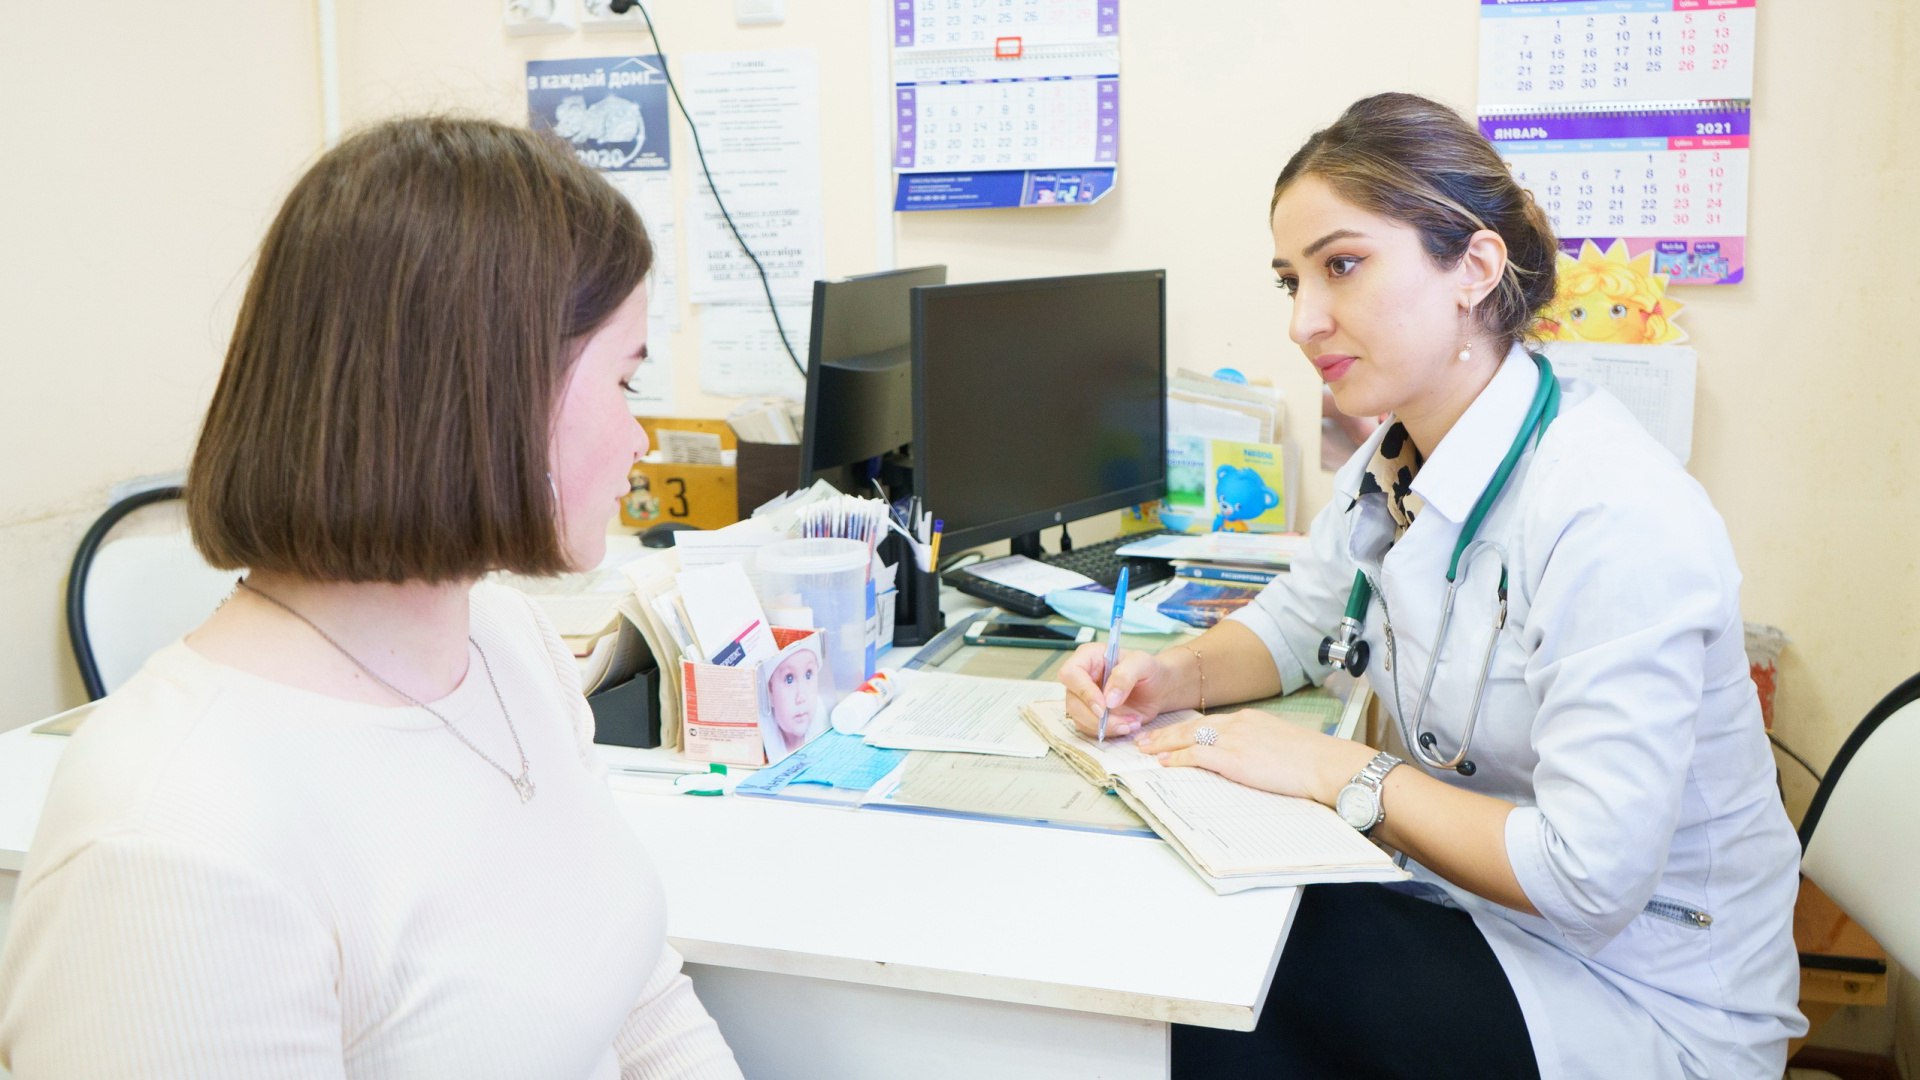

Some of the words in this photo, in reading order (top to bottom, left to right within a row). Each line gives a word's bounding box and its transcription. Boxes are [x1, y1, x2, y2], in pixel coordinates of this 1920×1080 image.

[922, 0, 935, 11] 15
[947, 0, 960, 9] 16
[921, 17, 935, 27] 22
[946, 16, 961, 26] 23
[972, 15, 986, 24] 24
[998, 13, 1012, 23] 25
[1024, 11, 1038, 22] 26
[1555, 18, 1560, 28] 1
[1587, 17, 1594, 27] 2
[1619, 16, 1626, 26] 3
[1652, 16, 1659, 24] 4
[1685, 12, 1692, 24] 5
[1718, 12, 1726, 22] 6
[921, 33, 936, 44] 29
[947, 32, 960, 42] 30
[972, 31, 984, 40] 31
[1523, 35, 1529, 44] 7
[1554, 34, 1561, 44] 8
[1586, 33, 1593, 42] 9
[1617, 31, 1630, 40] 10
[1648, 31, 1661, 40] 11
[1682, 29, 1696, 39] 12
[1715, 28, 1729, 38] 13
[1520, 51, 1532, 59] 14
[1552, 49, 1565, 59] 15
[1584, 48, 1597, 58] 16
[1616, 46, 1629, 56] 17
[1648, 46, 1662, 56] 18
[1681, 45, 1695, 55] 19
[1713, 43, 1729, 54] 20
[1518, 66, 1531, 75] 21
[1549, 65, 1564, 75] 22
[1582, 63, 1596, 73] 23
[1614, 62, 1629, 71] 24
[1646, 62, 1661, 72] 25
[1679, 60, 1694, 71] 26
[1712, 59, 1727, 70] 27
[1517, 81, 1532, 91] 28
[1549, 80, 1564, 90] 29
[1581, 78, 1596, 88] 30
[1613, 77, 1627, 87] 31
[1002, 88, 1008, 99] 1
[1028, 87, 1034, 97] 2
[926, 107, 934, 117] 5
[951, 106, 959, 116] 6
[976, 105, 984, 115] 7
[1002, 105, 1009, 115] 8
[1028, 104, 1035, 114] 9
[924, 123, 937, 134] 12
[948, 123, 962, 133] 13
[974, 123, 987, 132] 14
[1000, 121, 1012, 131] 15
[1024, 120, 1039, 131] 16
[1494, 126, 1549, 140] ЯНВАРЬ
[1696, 122, 1731, 134] 2021
[924, 139, 937, 150] 19
[947, 139, 961, 149] 20
[972, 138, 985, 148] 21
[998, 137, 1012, 148] 22
[1023, 137, 1038, 147] 23
[576, 148, 624, 168] 2020
[921, 155, 936, 165] 26
[946, 155, 960, 165] 27
[996, 153, 1011, 163] 29
[1647, 153, 1652, 163] 1
[1679, 152, 1686, 164] 2
[1713, 150, 1720, 162] 3
[1518, 170, 1526, 181] 4
[1550, 171, 1557, 181] 5
[1582, 170, 1589, 180] 6
[1614, 169, 1621, 179] 7
[1646, 169, 1653, 179] 8
[1679, 168, 1686, 178] 9
[1709, 167, 1724, 177] 10
[1548, 185, 1561, 195] 12
[1579, 186, 1592, 195] 13
[1611, 185, 1624, 194] 14
[1643, 184, 1657, 194] 15
[1676, 184, 1690, 193] 16
[1708, 182, 1722, 193] 17
[1547, 200, 1560, 212] 19
[1577, 200, 1592, 211] 20
[1609, 200, 1622, 210] 21
[1642, 199, 1656, 209] 22
[1674, 199, 1689, 209] 23
[1707, 198, 1722, 208] 24
[1577, 215, 1592, 225] 27
[1609, 215, 1624, 225] 28
[1641, 215, 1656, 224] 29
[1673, 214, 1689, 224] 30
[1707, 214, 1720, 224] 31
[666, 477, 689, 517] 3
